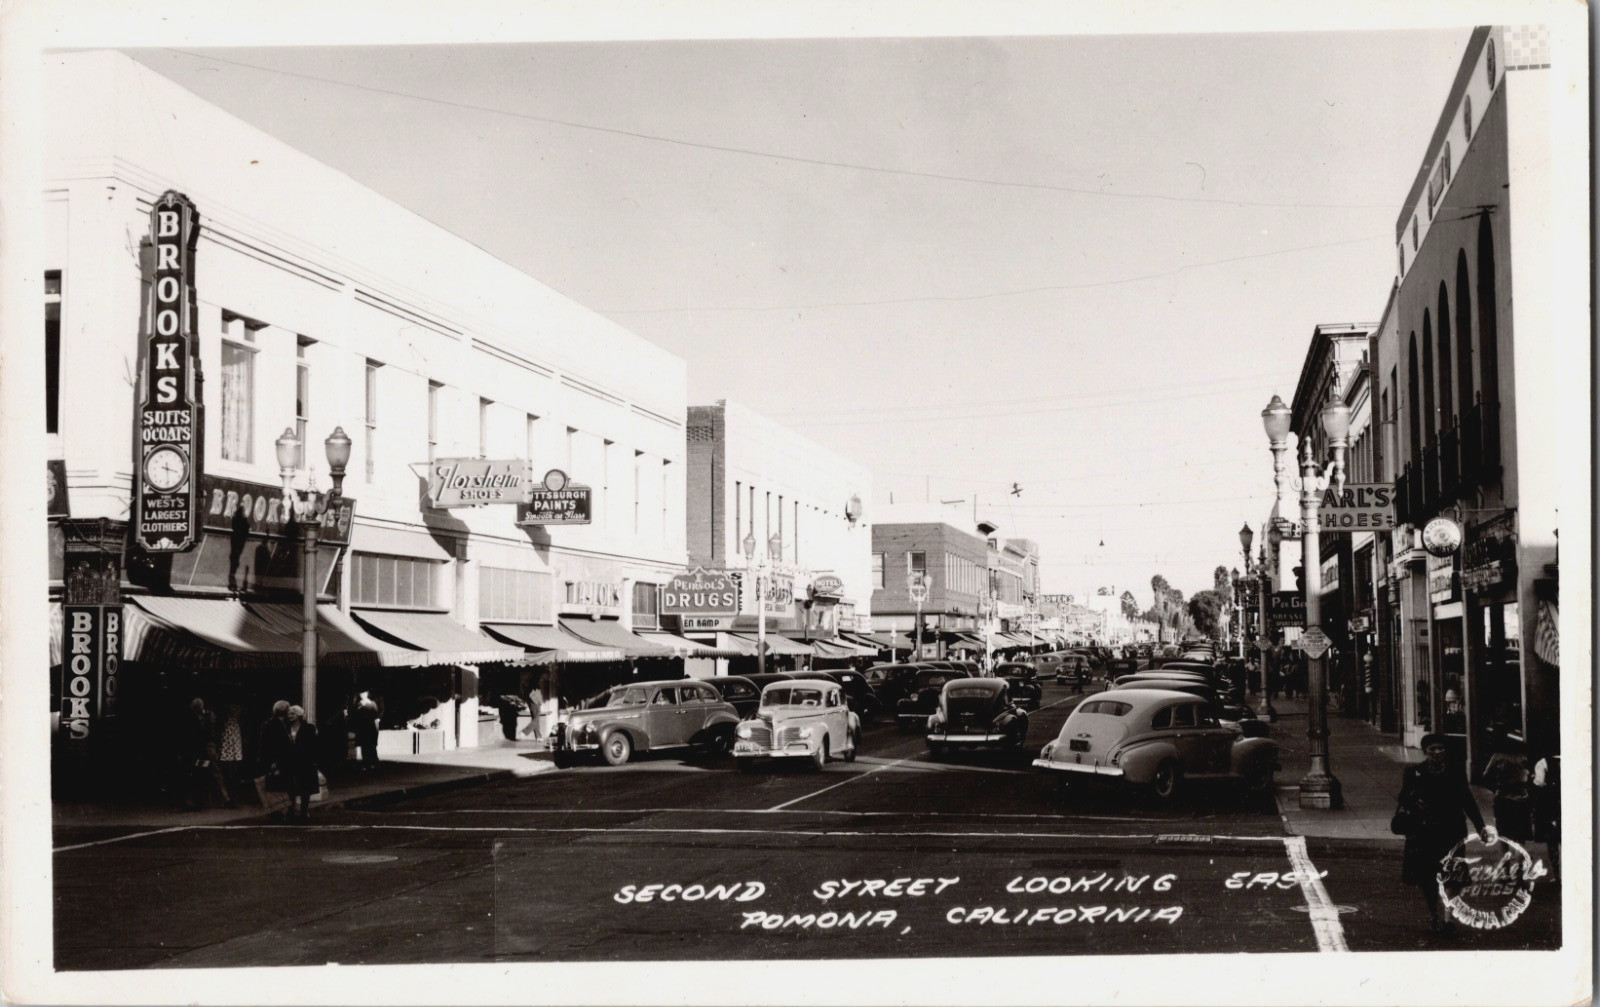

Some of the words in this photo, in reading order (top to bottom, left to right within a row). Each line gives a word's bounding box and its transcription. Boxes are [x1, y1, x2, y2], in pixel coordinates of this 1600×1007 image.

[157, 210, 181, 404] BROOKS
[143, 410, 191, 426] SUITS
[436, 463, 521, 500] Florsheim
[461, 489, 503, 499] SHOES
[1321, 487, 1390, 508] ARL'S
[147, 498, 185, 508] WEST'S
[534, 500, 576, 510] PAINTS
[145, 510, 187, 520] LARGEST
[141, 522, 188, 532] CLOTHIERS
[665, 592, 734, 607] DRUGS
[697, 618, 720, 628] KAMP
[70, 611, 92, 740] BROOKS
